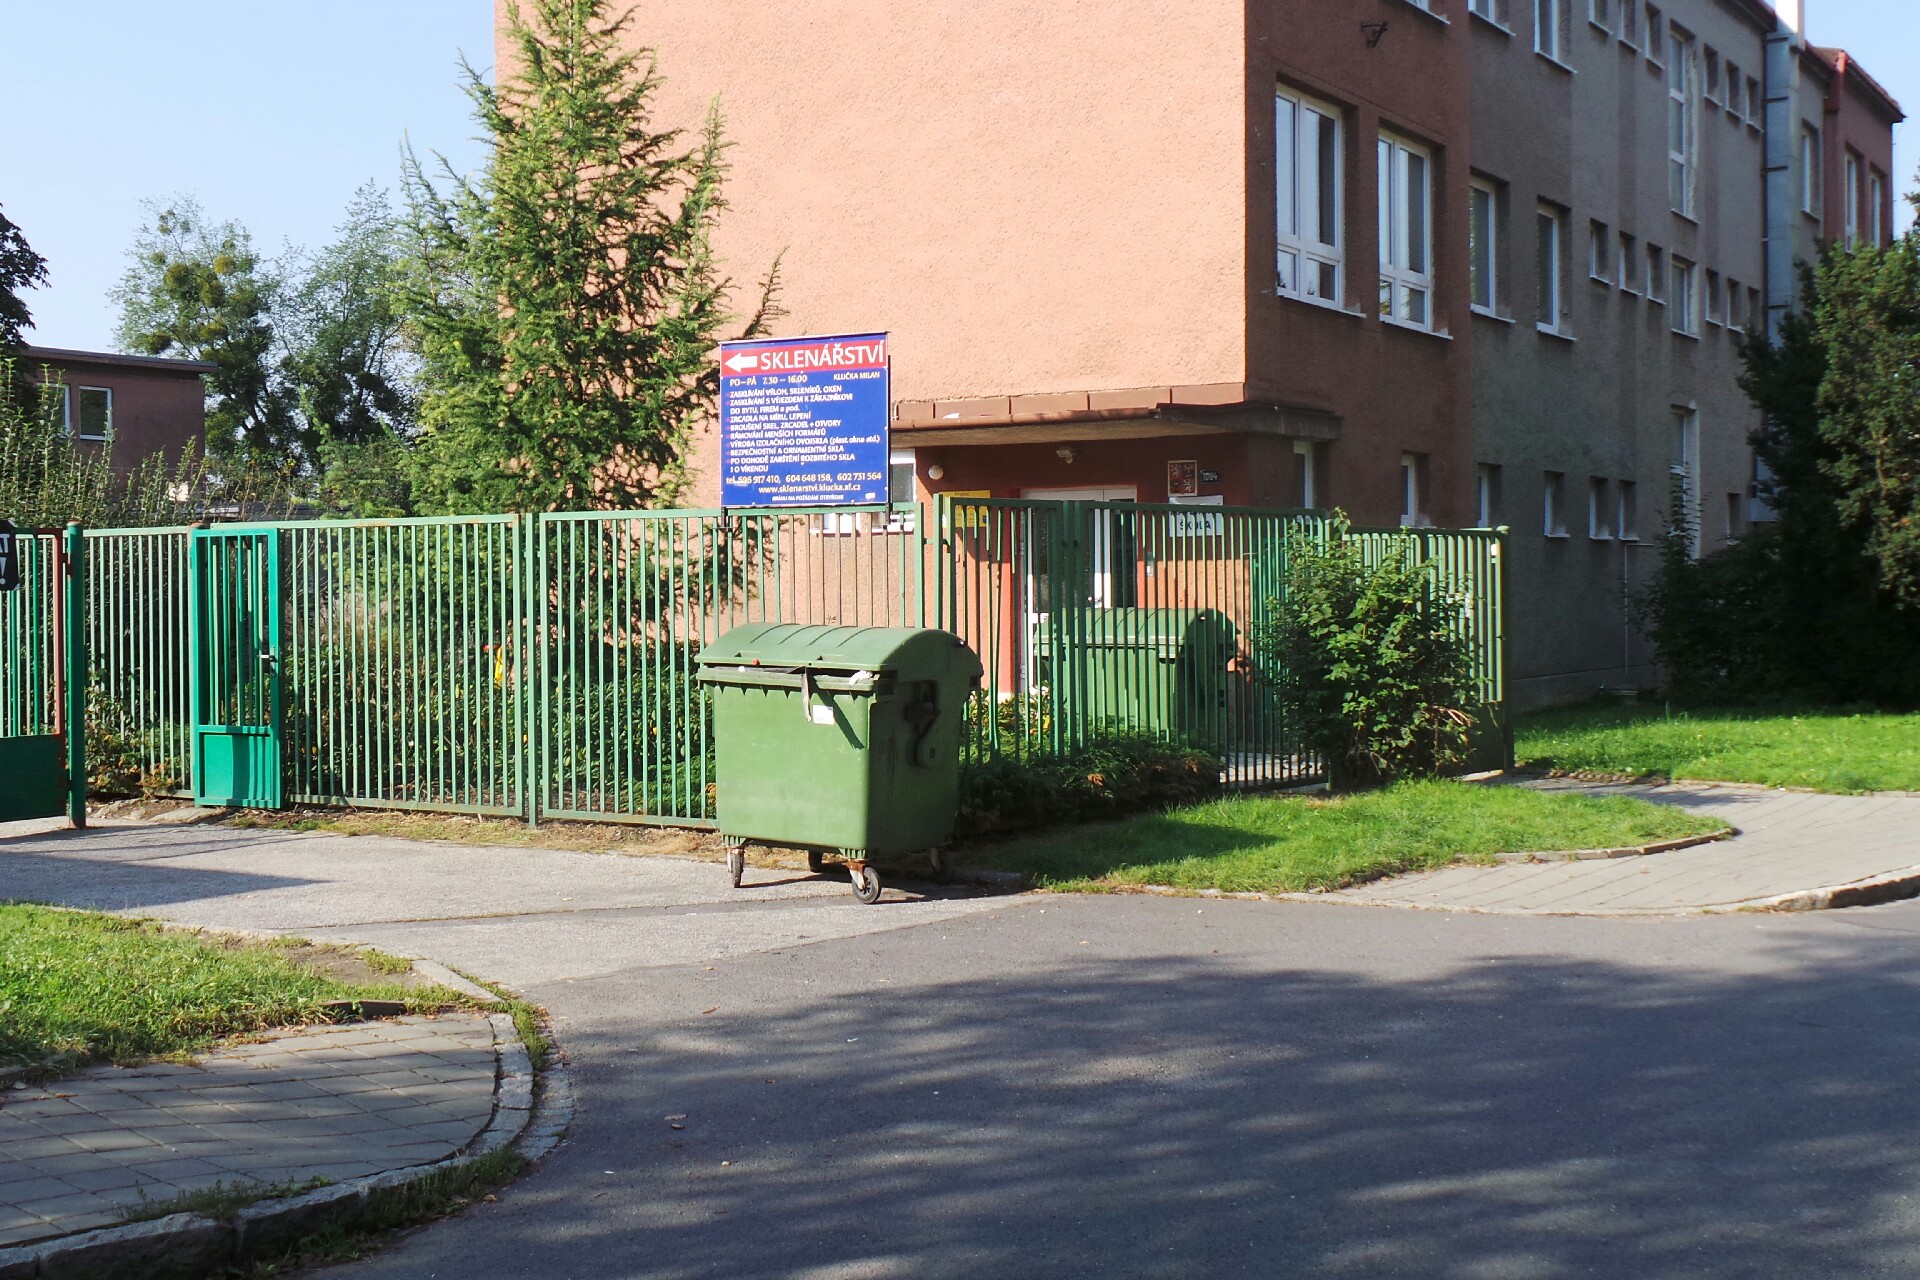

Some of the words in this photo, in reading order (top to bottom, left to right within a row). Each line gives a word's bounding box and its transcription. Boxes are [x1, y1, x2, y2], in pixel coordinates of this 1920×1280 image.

[760, 340, 884, 370] SKLENÁŘSTVÍ
[788, 374, 807, 383] 16.00
[834, 371, 858, 380] KLUČKA
[860, 371, 880, 379] MILAN
[823, 384, 842, 393] OKEN
[731, 407, 740, 415] DO
[760, 405, 779, 413] FIREM
[786, 403, 800, 413] pod.
[730, 414, 758, 423] ZRCADLA
[789, 410, 811, 420] LEPENÍ
[731, 422, 762, 431] BROUŠENÍ
[780, 421, 809, 430] ZRCADEL
[814, 419, 841, 427] OTVORY
[765, 429, 793, 439] MENŠÍCH
[795, 427, 826, 437] FORMÁTŮ
[730, 439, 756, 449] VÝROBA
[756, 437, 795, 448] IZOLAČNÍHO
[731, 446, 776, 457] BEZPEČNOSTNÍ
[783, 444, 826, 455] ORNAMENTNÍ
[827, 444, 844, 453] SKLA
[731, 456, 740, 465] PO
[741, 454, 769, 464] DOHODĚ
[800, 452, 837, 462] ROZBITÉHO
[838, 453, 855, 461] SKLA
[741, 464, 769, 473] VÍKENDU
[753, 475, 765, 484] 917
[785, 474, 800, 483] 604
[801, 474, 816, 482] 648
[817, 473, 833, 482] 158,
[837, 473, 852, 481] 602
[853, 472, 866, 480] 731
[866, 472, 882, 480] 564
